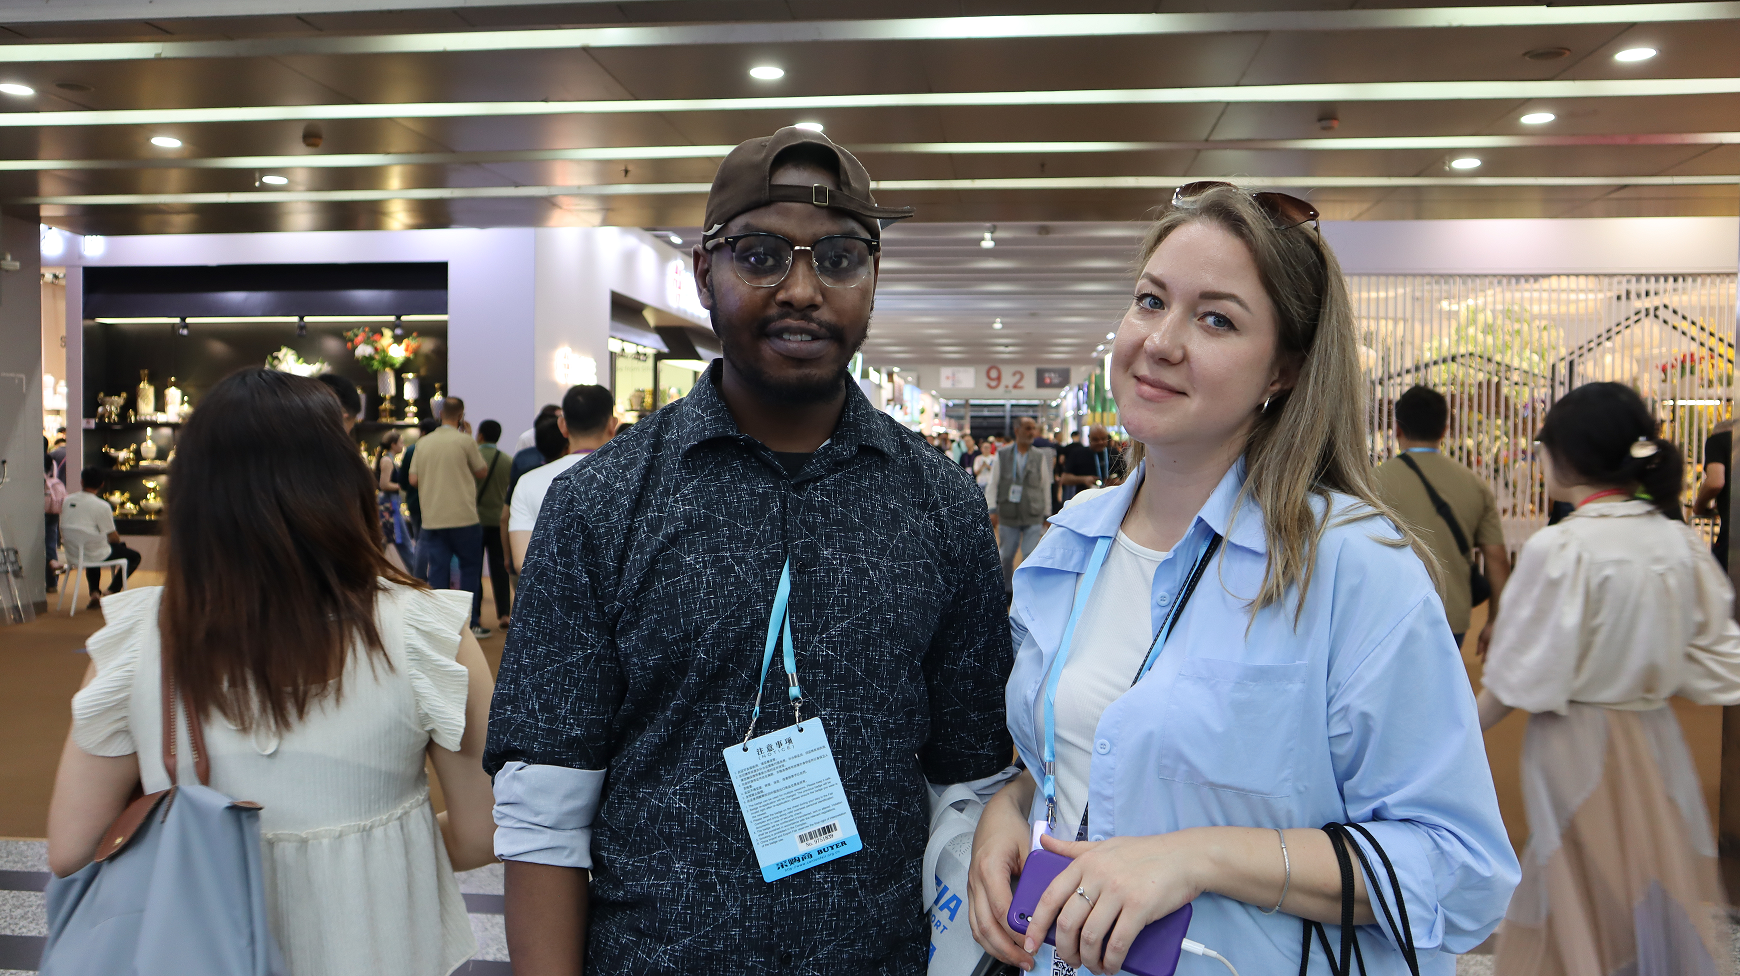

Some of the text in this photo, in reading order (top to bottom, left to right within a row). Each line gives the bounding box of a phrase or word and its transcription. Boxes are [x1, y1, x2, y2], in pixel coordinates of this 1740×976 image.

[986, 365, 1025, 389] 9.2
[776, 840, 848, 870] 采购商 BUYER
[935, 874, 962, 922] IA
